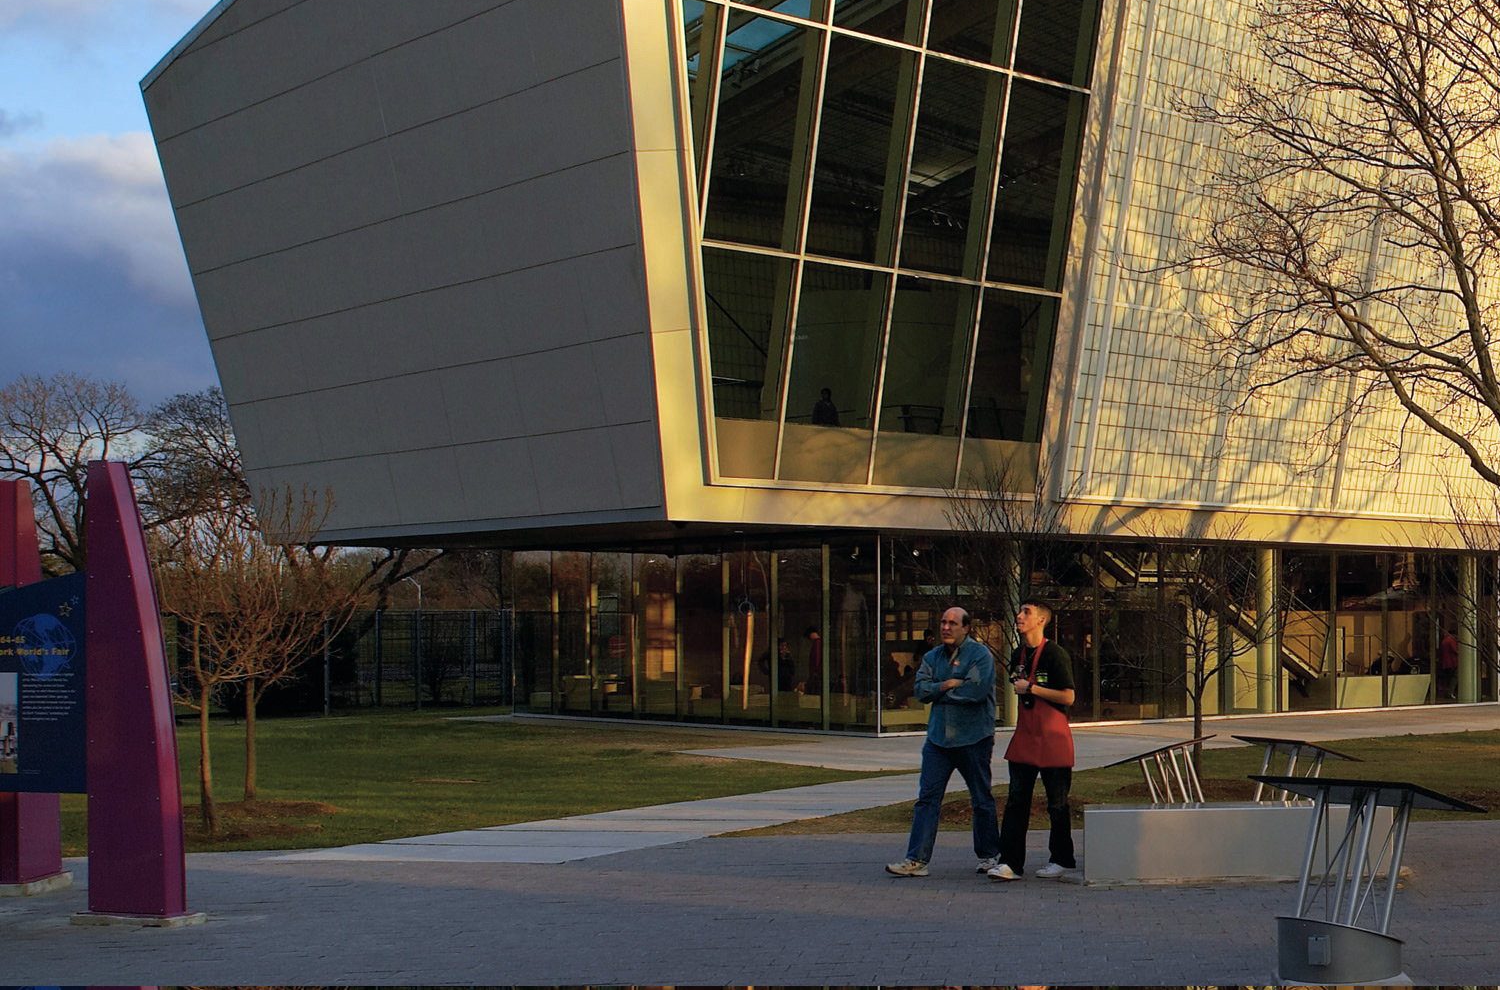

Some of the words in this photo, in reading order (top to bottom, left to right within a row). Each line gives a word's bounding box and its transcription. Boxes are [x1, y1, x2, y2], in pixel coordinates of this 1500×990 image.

[0, 636, 26, 644] 64-65
[0, 648, 14, 656] ork
[16, 648, 49, 656] World's
[51, 647, 70, 656] Fair
